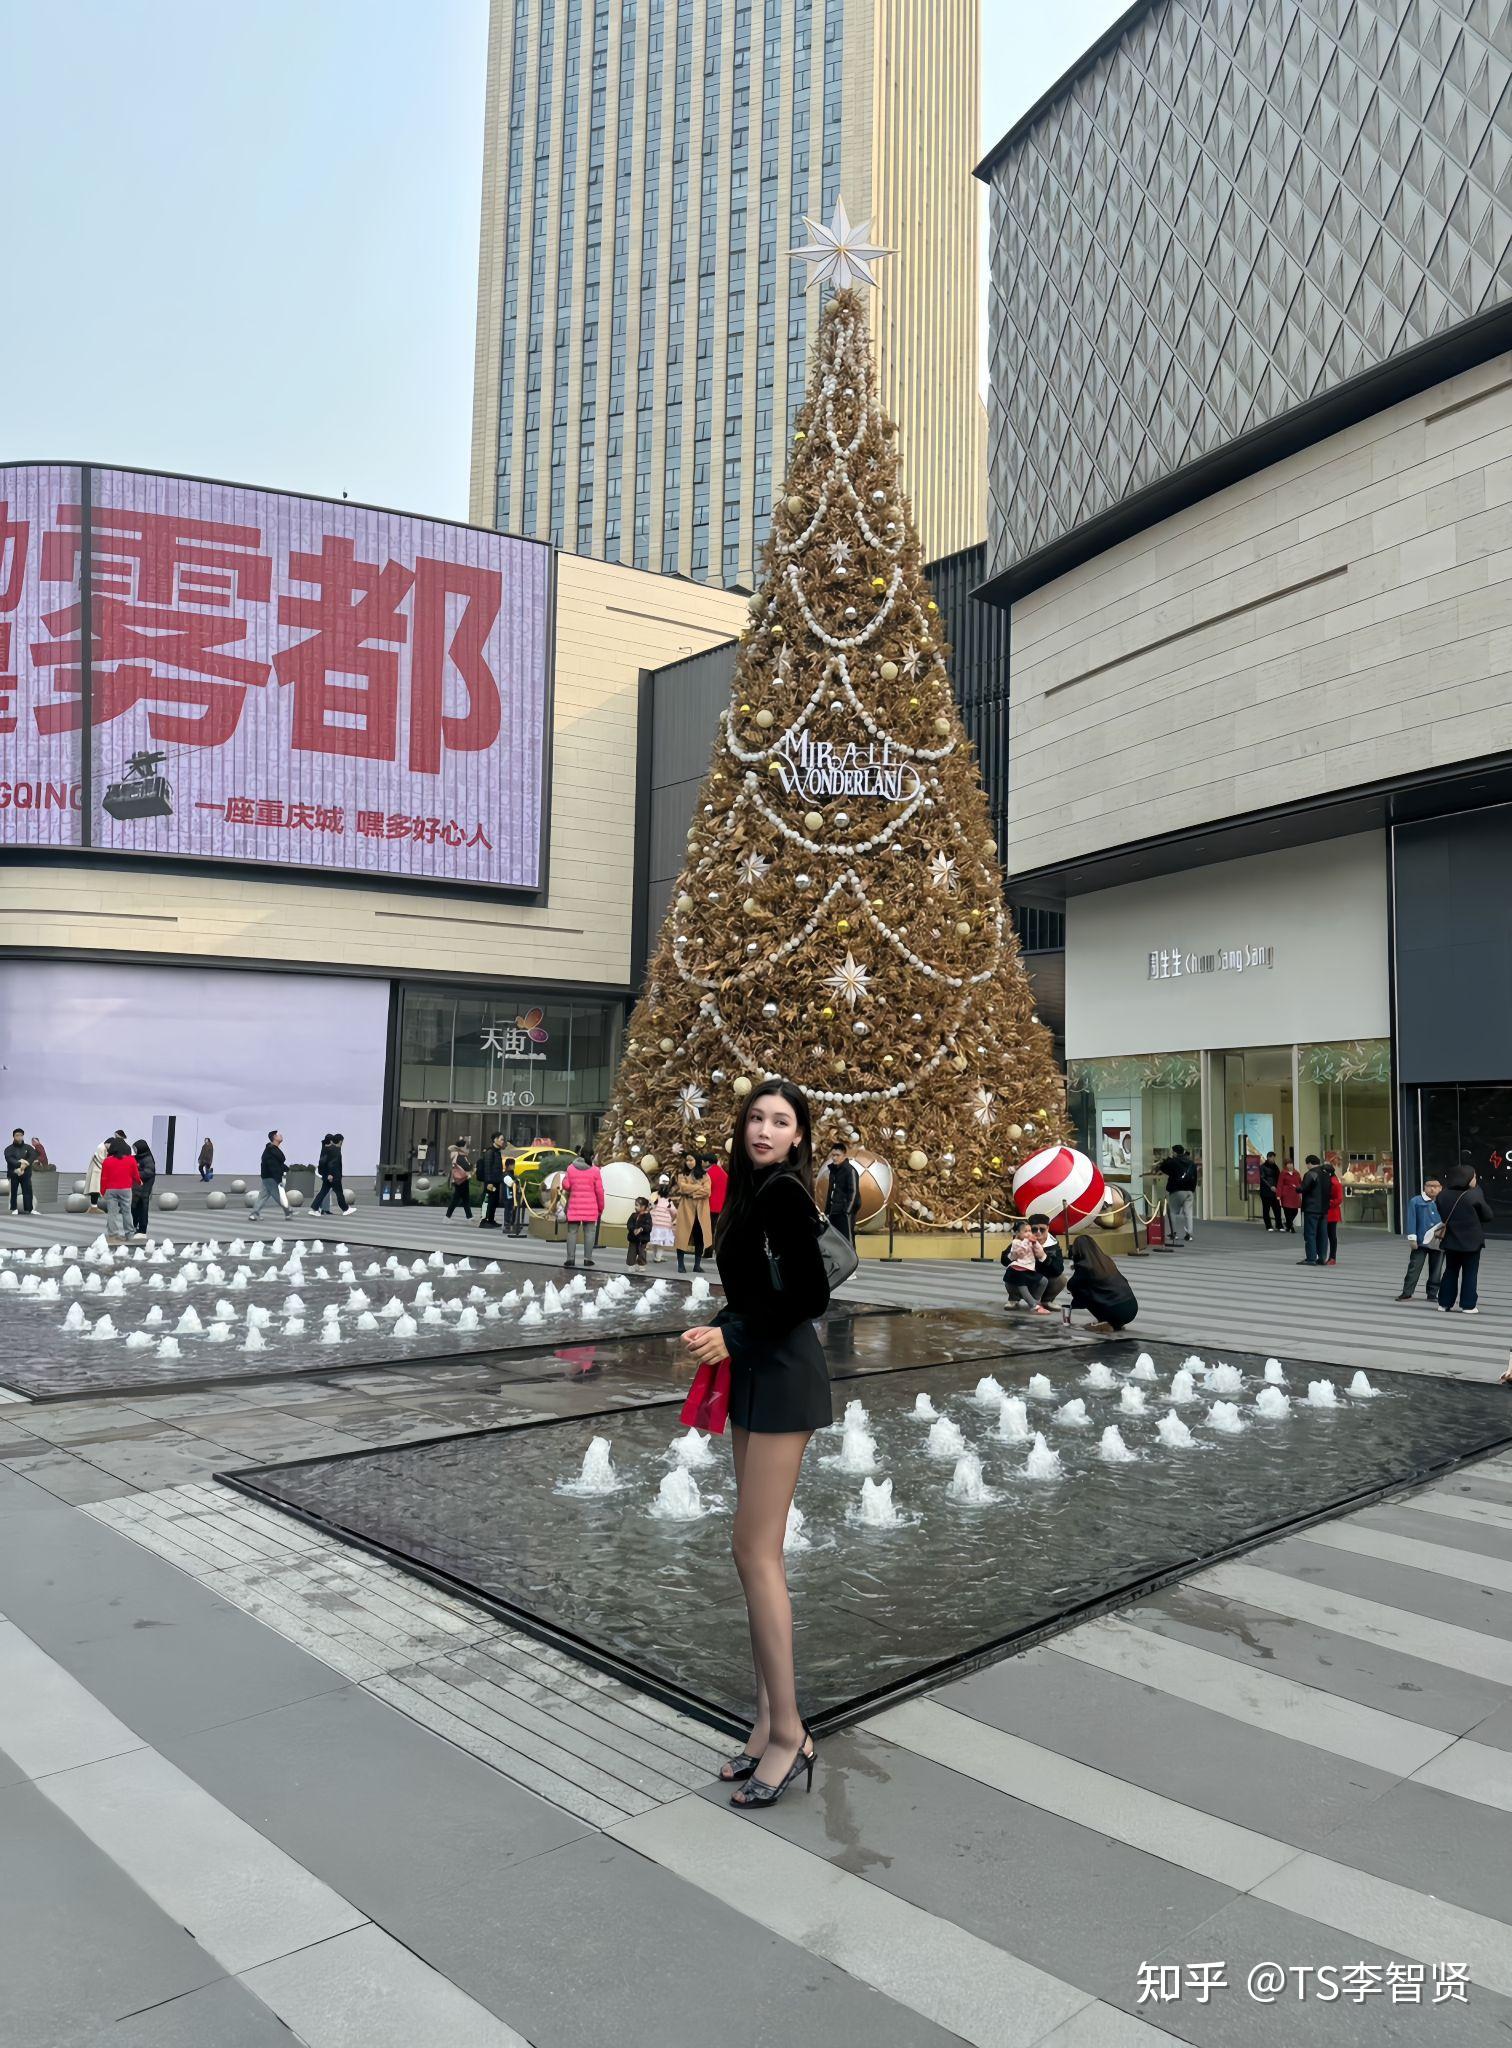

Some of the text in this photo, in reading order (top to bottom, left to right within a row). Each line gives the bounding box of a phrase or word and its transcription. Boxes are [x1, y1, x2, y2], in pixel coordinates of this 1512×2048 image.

[775, 757, 921, 803] WONDERLAND
[194, 796, 345, 835] 一座重庆城
[1185, 953, 1215, 974] Chow
[1218, 949, 1243, 972] Sang
[1246, 945, 1274, 969] Sang
